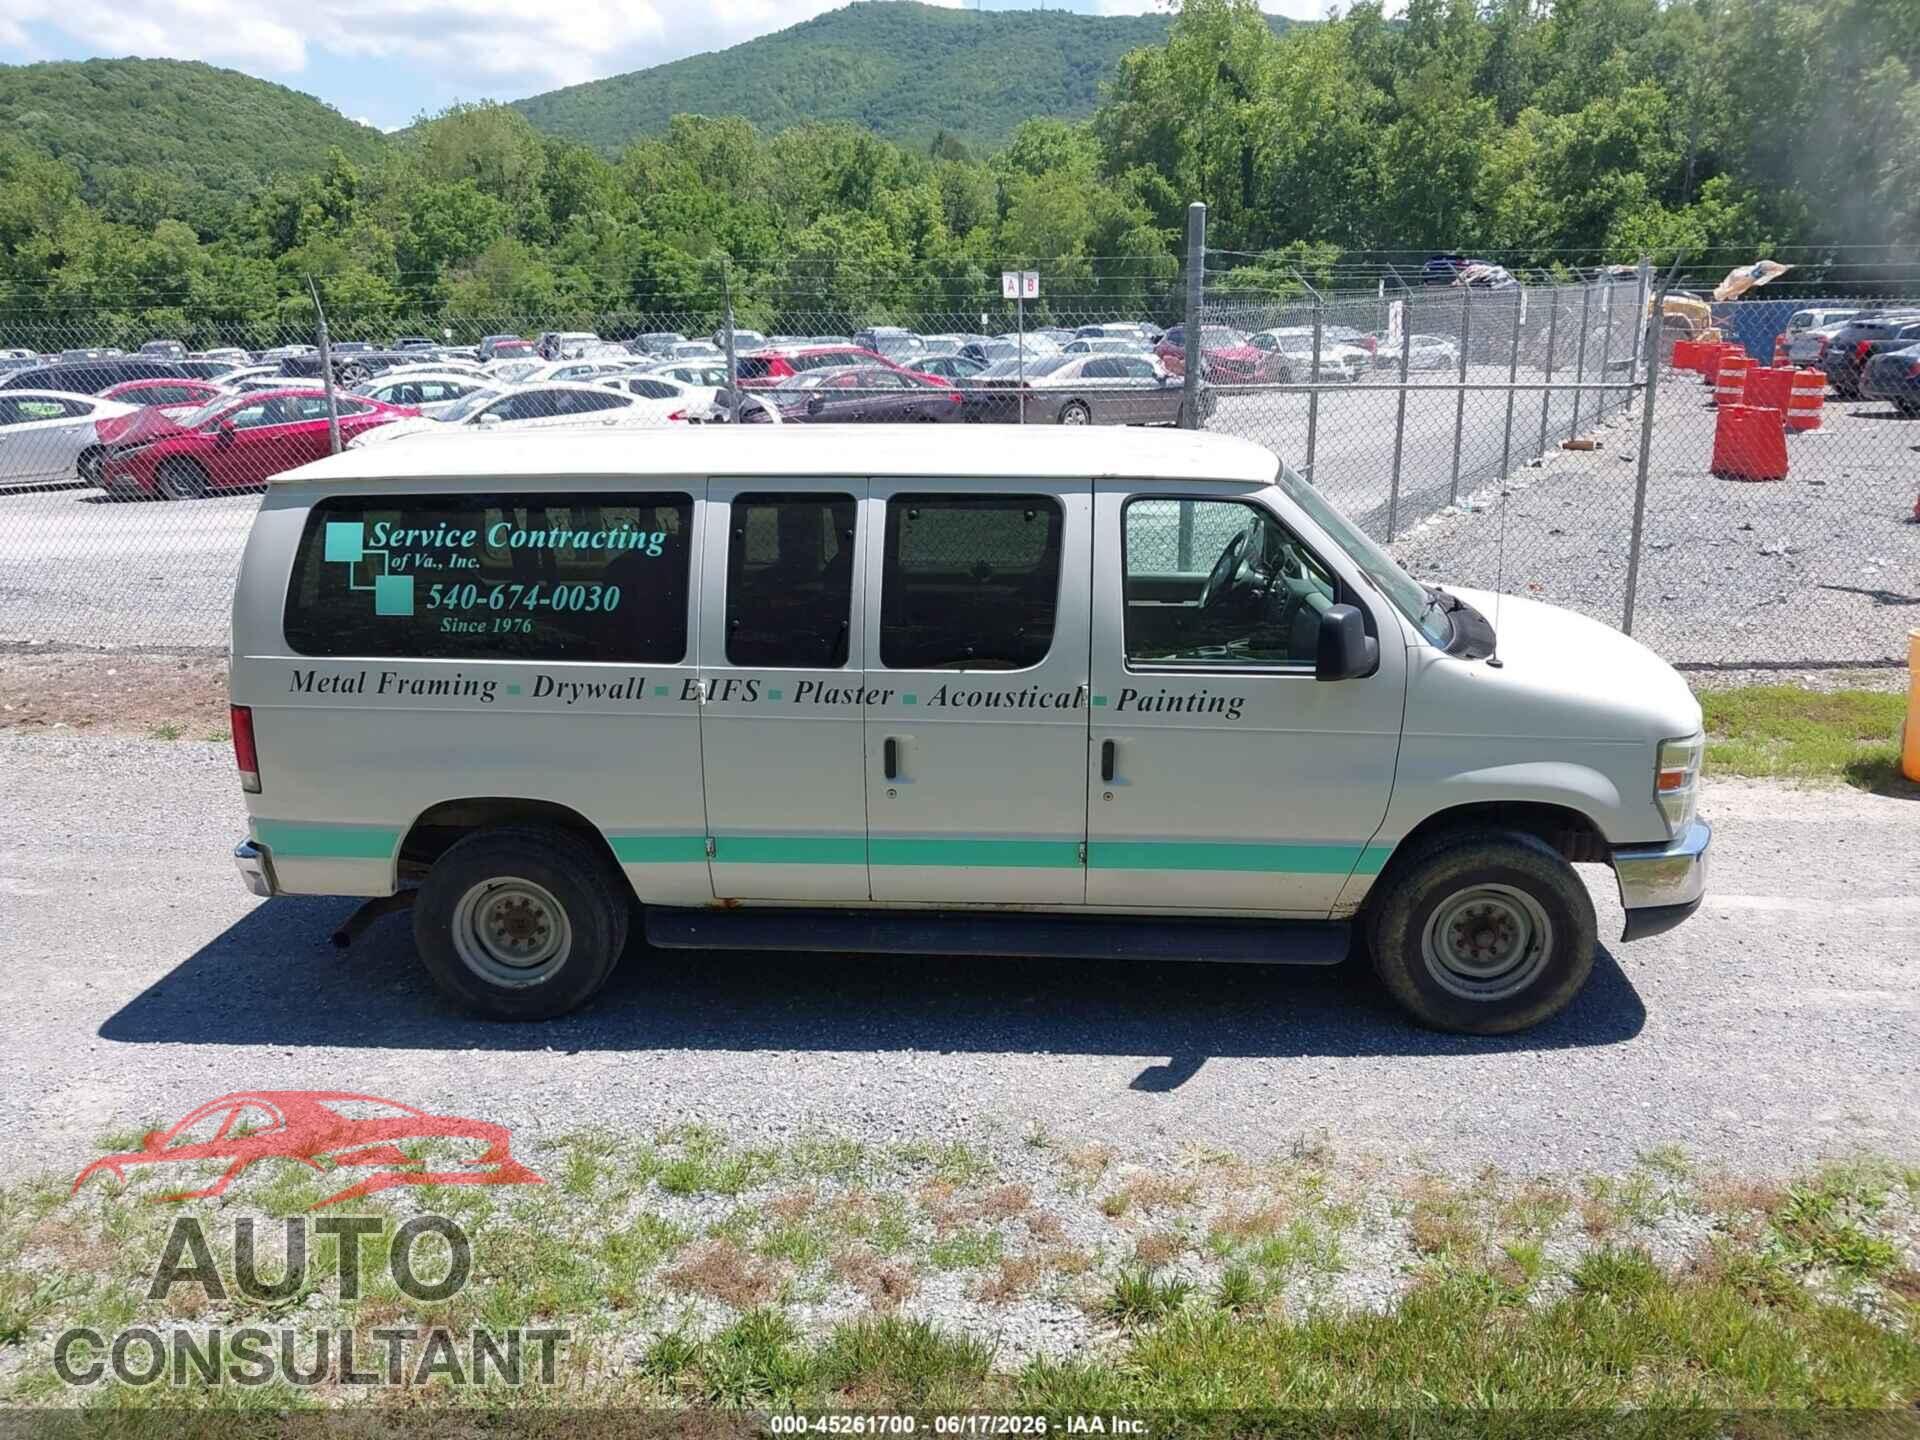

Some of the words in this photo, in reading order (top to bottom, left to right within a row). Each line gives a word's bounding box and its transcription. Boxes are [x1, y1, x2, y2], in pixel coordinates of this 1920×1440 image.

[1007, 279, 1015, 292] A
[1027, 278, 1034, 292] B
[368, 521, 477, 547] Service
[487, 522, 667, 557] Contracting
[390, 552, 412, 572] of
[415, 553, 443, 569] Va.,
[448, 554, 480, 569] Inc.
[426, 583, 621, 612] 540-674-0030
[440, 617, 487, 633] Since
[492, 618, 533, 633] 1976
[288, 670, 367, 695] Metal
[377, 672, 498, 703] Framing
[532, 675, 647, 704] Drywall
[679, 678, 762, 702] EIFS
[793, 680, 895, 706] Plaster
[928, 684, 1084, 709] Acoustical
[1116, 688, 1245, 721] Painting
